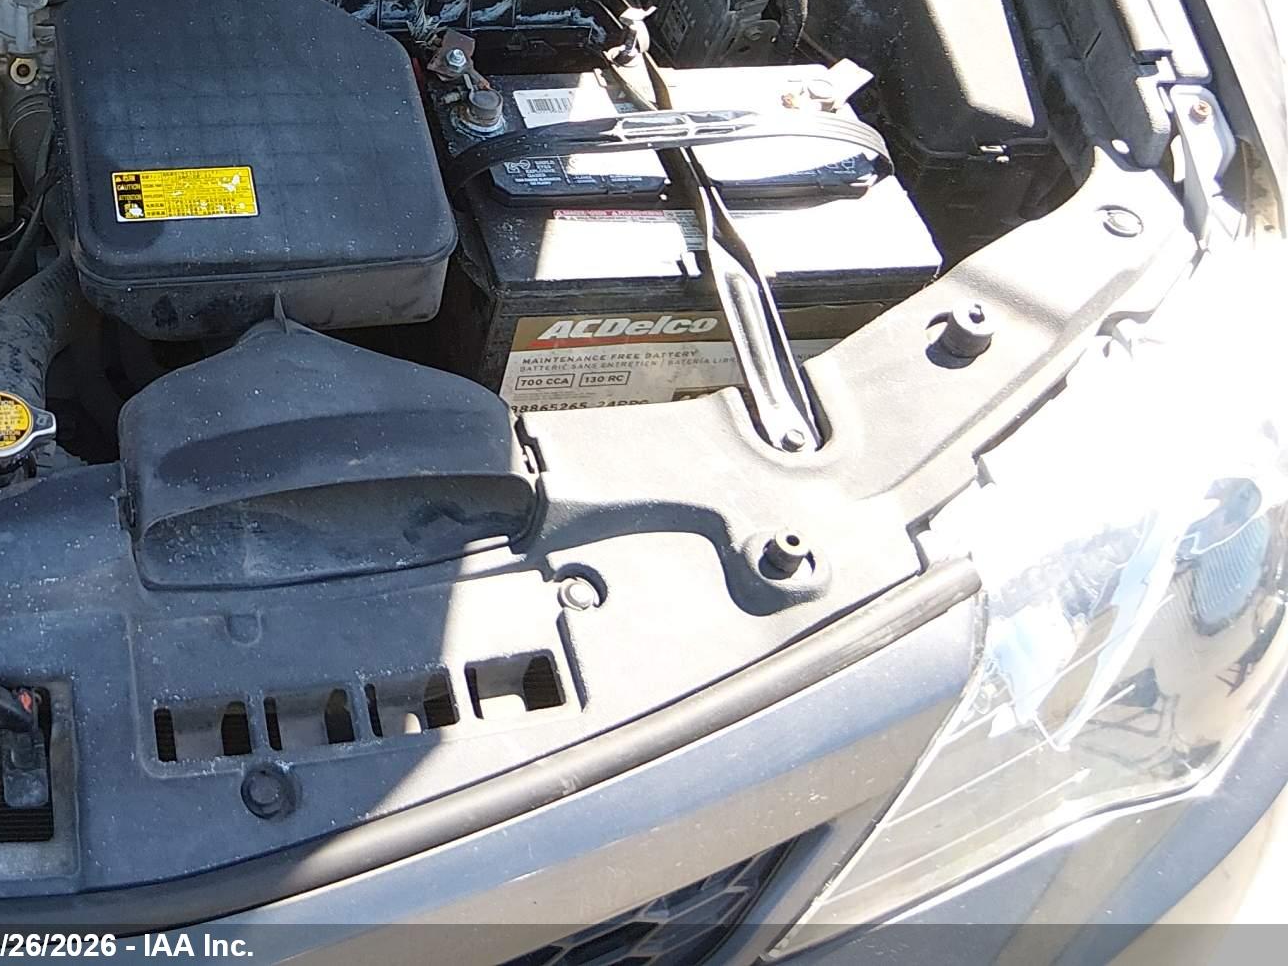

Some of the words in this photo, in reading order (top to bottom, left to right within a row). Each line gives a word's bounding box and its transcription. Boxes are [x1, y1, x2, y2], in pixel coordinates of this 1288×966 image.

[537, 316, 719, 340] ACDelco
[522, 354, 607, 364] MAINTENANCE
[611, 351, 641, 361] FREE
[644, 349, 698, 360] BATTERY
[570, 361, 598, 371] SANS
[520, 378, 543, 387] 700
[546, 376, 570, 386] CCA
[584, 375, 606, 384] 130
[608, 373, 626, 383] RC
